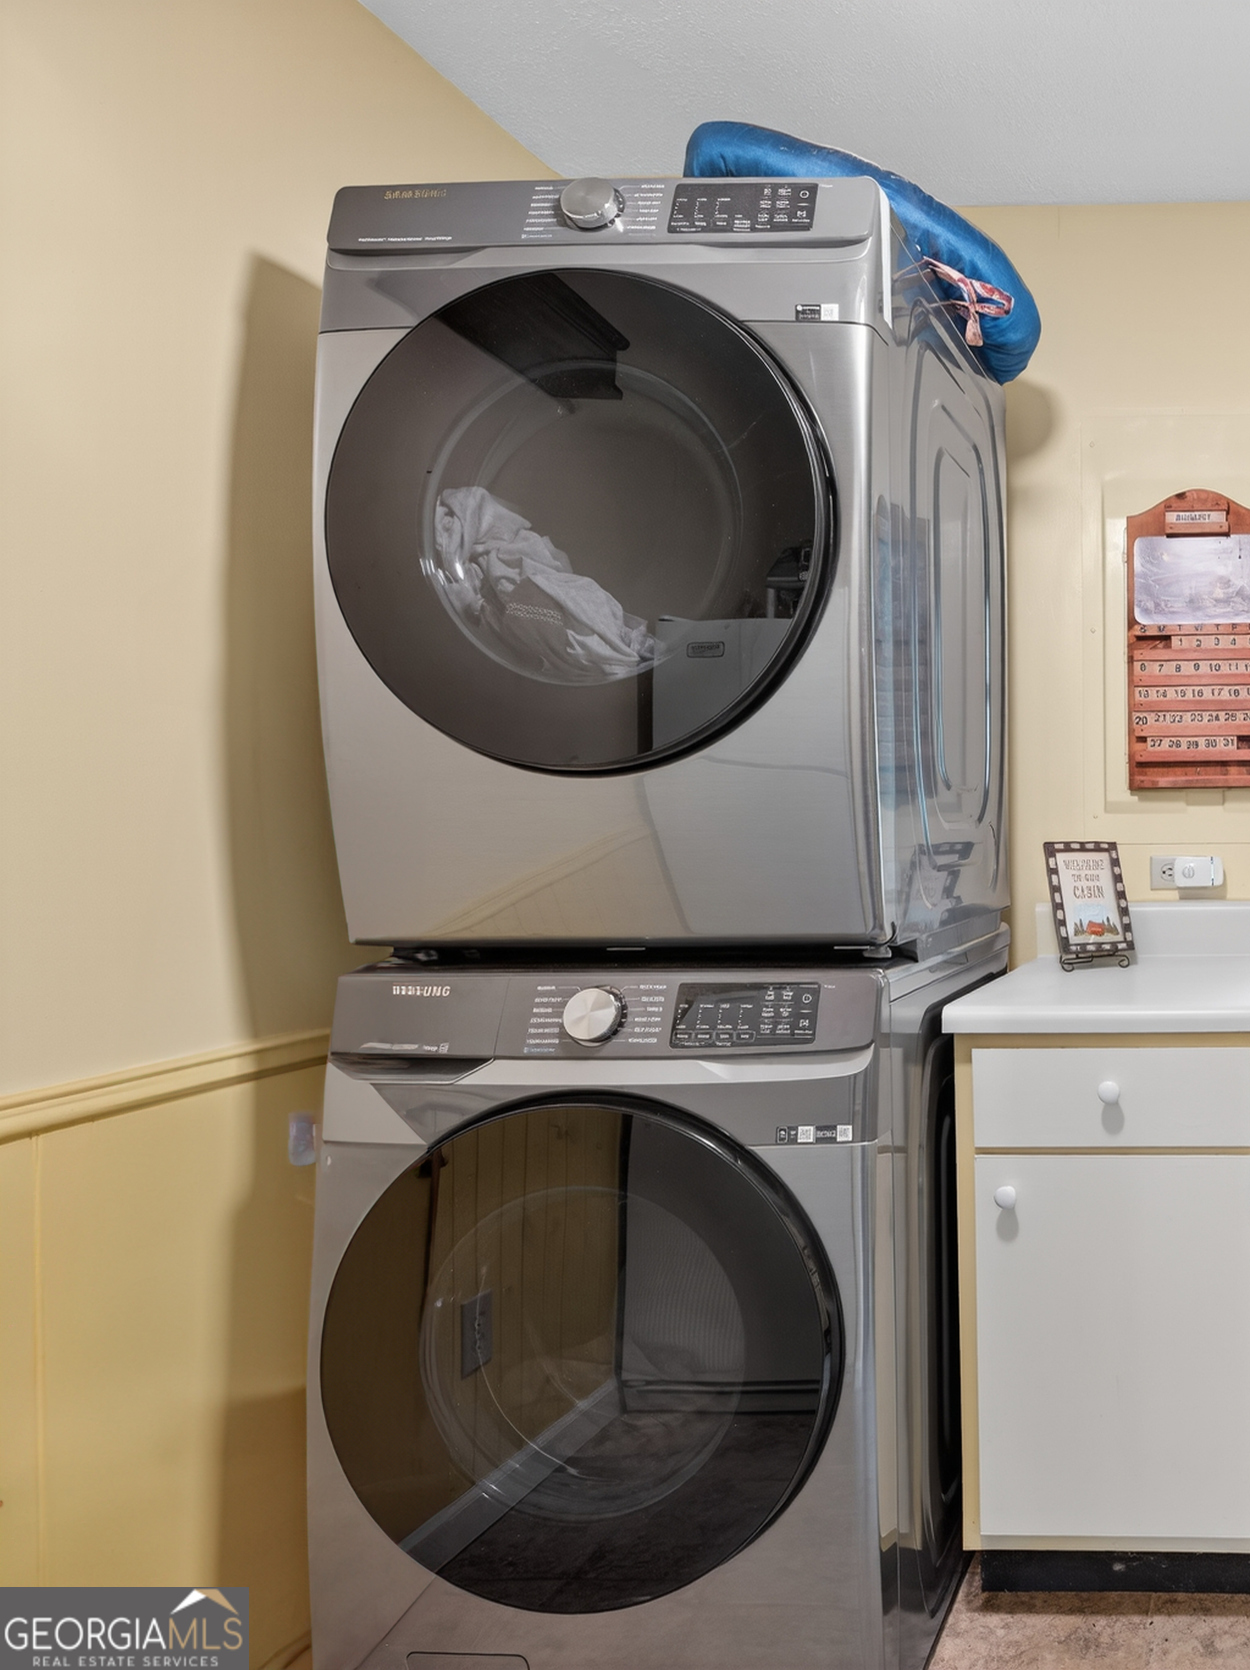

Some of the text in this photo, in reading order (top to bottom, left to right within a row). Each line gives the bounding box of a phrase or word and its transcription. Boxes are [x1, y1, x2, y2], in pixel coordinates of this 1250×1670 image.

[1178, 637, 1182, 646] 1
[1195, 639, 1202, 647] 2
[1214, 637, 1220, 646] 3
[1230, 638, 1236, 646] 4
[1158, 664, 1164, 672] 7
[1175, 664, 1182, 673] 8
[1209, 663, 1221, 672] 10
[1229, 663, 1238, 671] 11
[1192, 689, 1204, 698] 16
[1212, 688, 1224, 697] 17
[1135, 716, 1148, 725] 20
[1154, 713, 1167, 722] 21
[1074, 885, 1105, 899] CABIN
